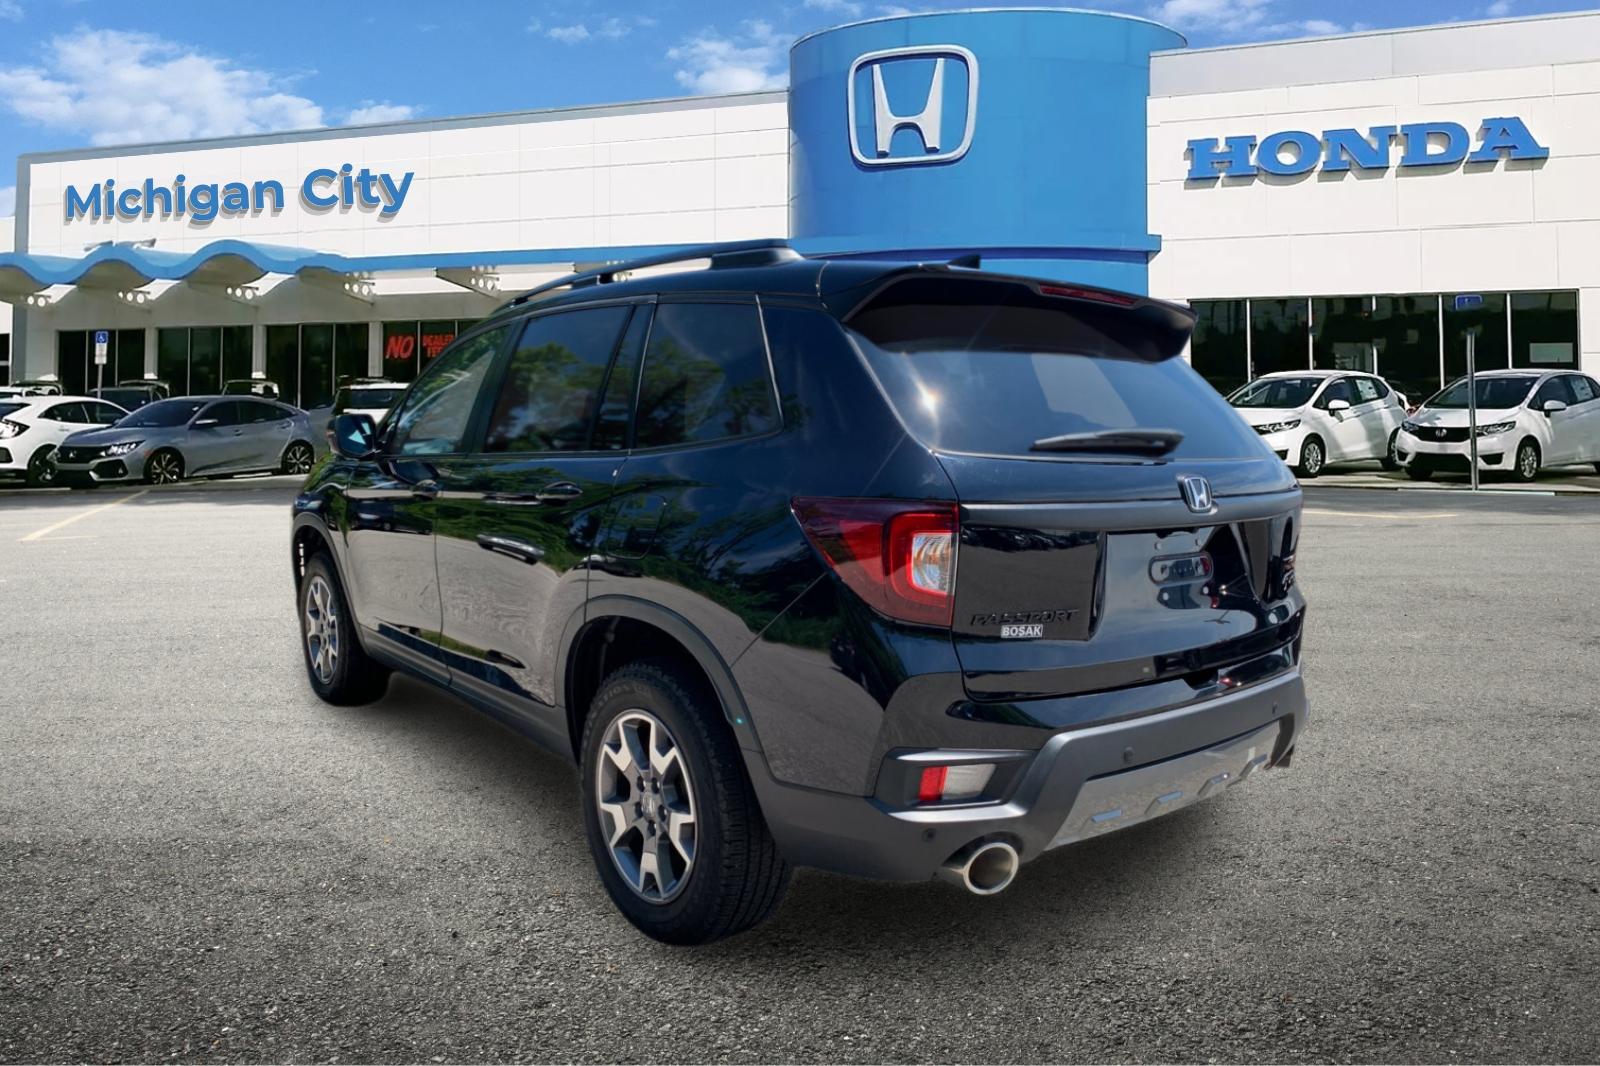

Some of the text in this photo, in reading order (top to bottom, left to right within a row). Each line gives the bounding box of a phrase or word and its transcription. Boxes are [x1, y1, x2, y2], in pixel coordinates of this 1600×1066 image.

[1186, 116, 1550, 179] HONDA
[65, 163, 415, 222] Michigan City
[385, 335, 415, 359] NO
[970, 609, 1080, 626] PASSPORT
[1002, 625, 1042, 637] BOSAK
